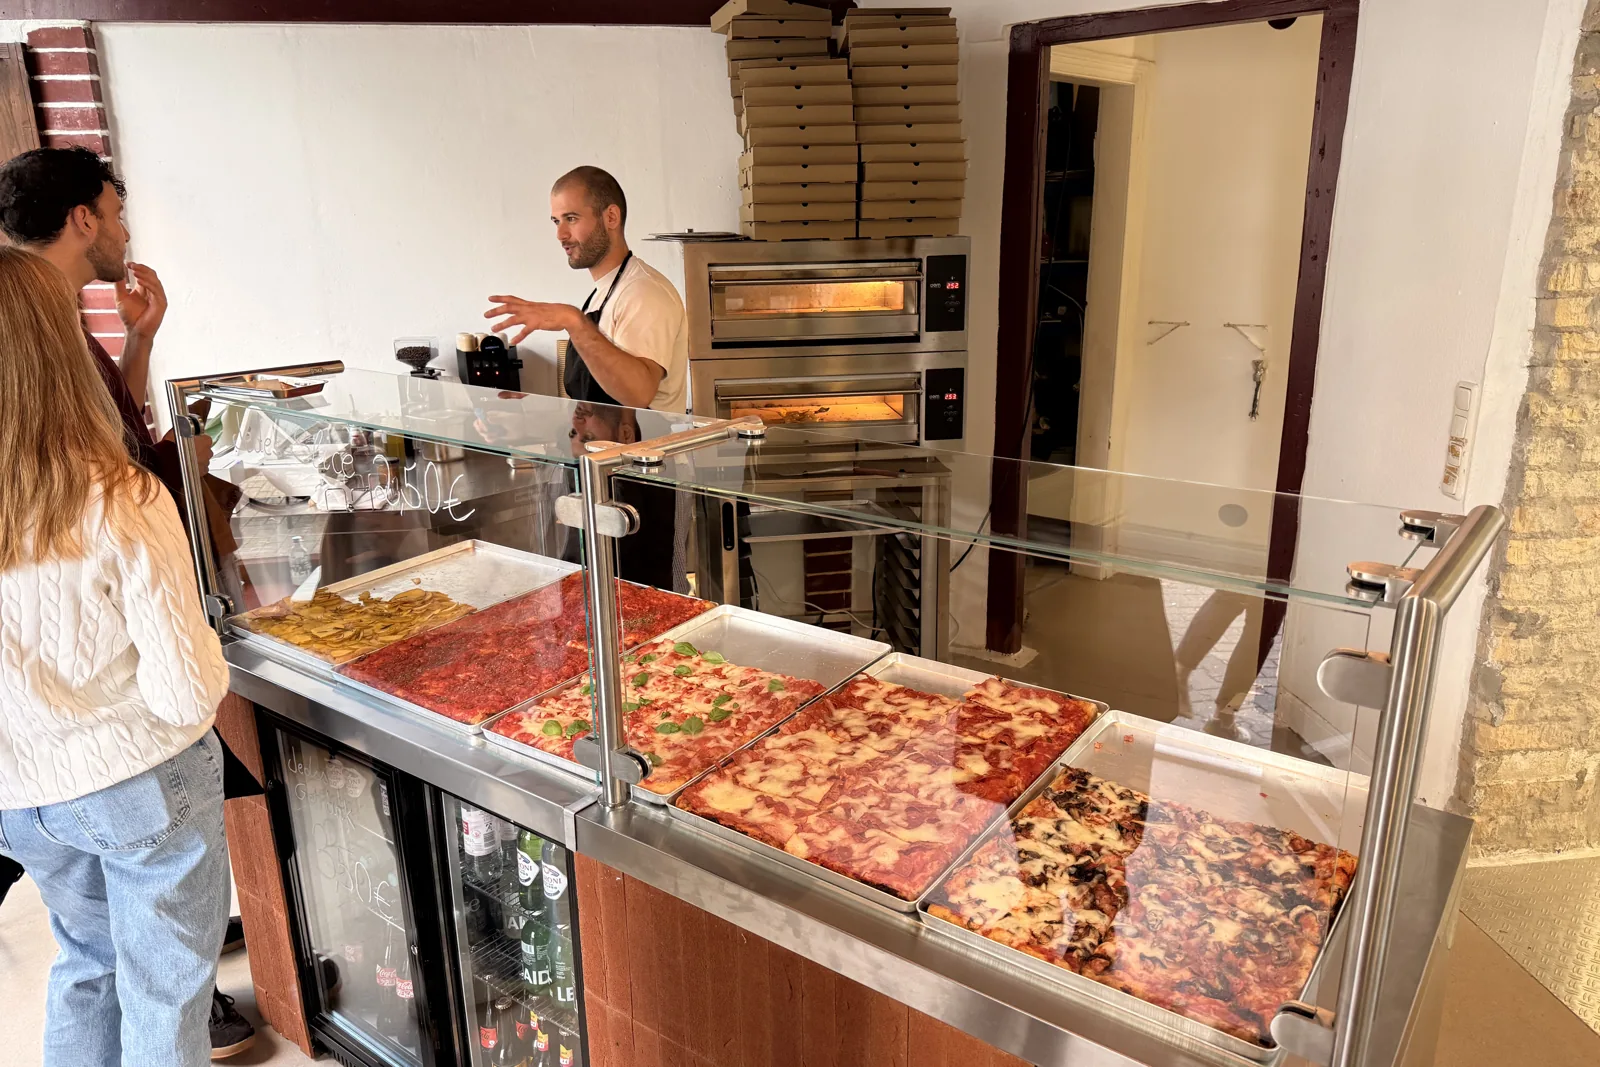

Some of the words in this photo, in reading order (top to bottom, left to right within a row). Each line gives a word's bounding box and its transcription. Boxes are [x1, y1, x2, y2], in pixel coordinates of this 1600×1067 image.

[946, 282, 960, 290] 252
[372, 454, 476, 522] 2,50€
[523, 967, 551, 986] AID
